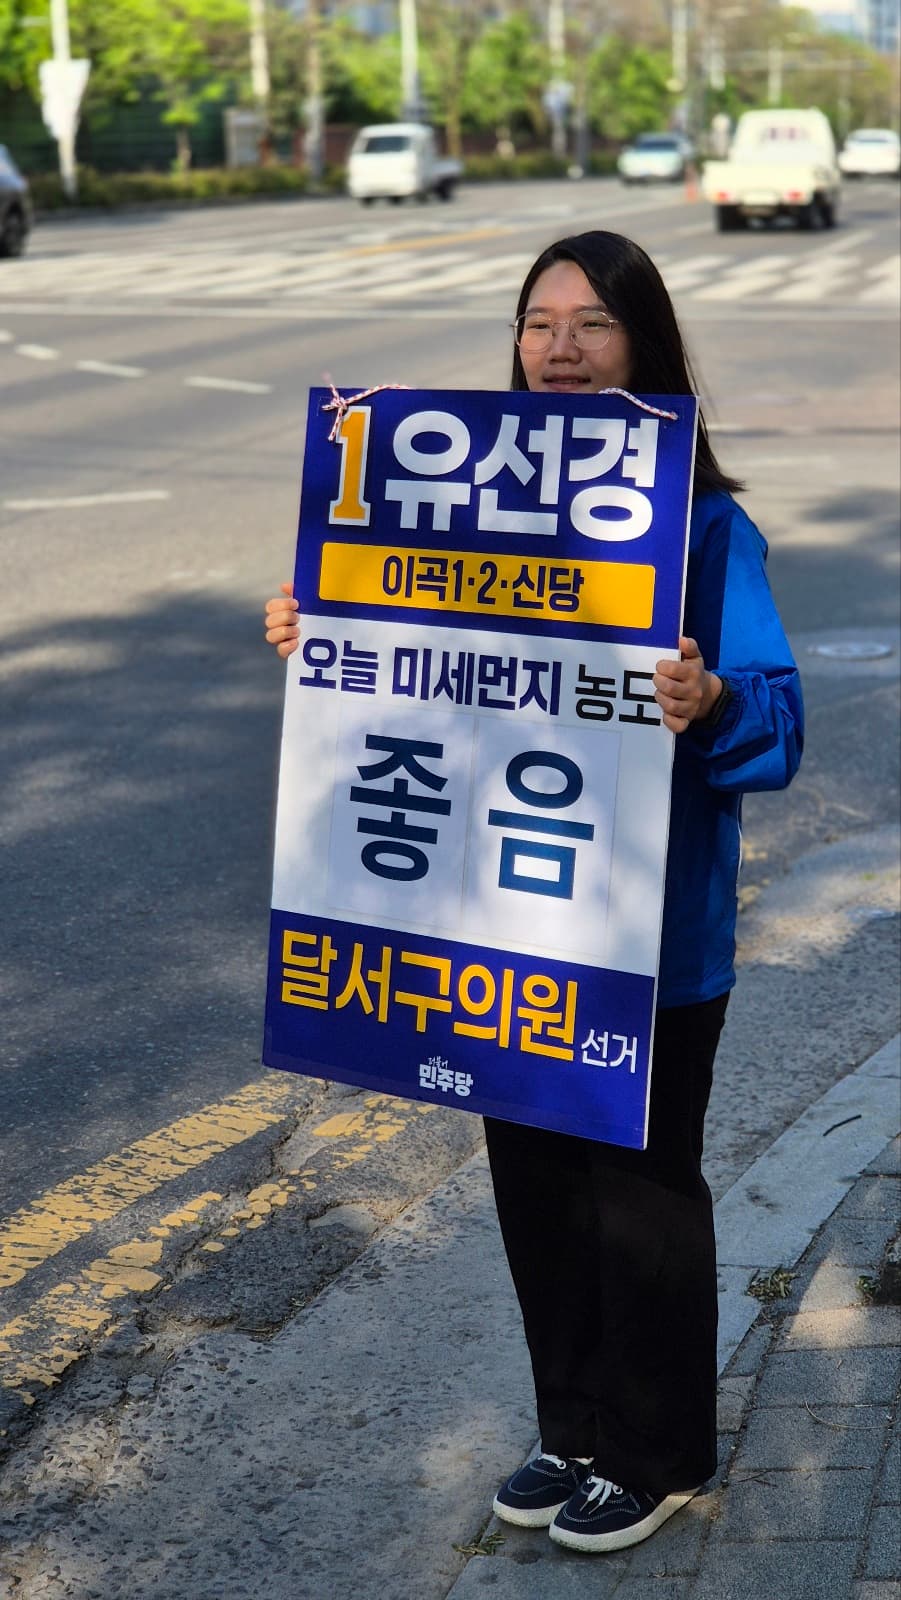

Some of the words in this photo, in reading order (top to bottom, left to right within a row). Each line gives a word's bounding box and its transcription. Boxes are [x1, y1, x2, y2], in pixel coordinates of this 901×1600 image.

[328, 405, 371, 526] 1
[385, 410, 660, 542] 유선경
[382, 555, 585, 613] 이곡1·2·신당
[299, 637, 379, 695] 오늘
[391, 647, 562, 716] 미세먼지
[575, 664, 661, 727] 농도
[349, 734, 595, 900] 좋음
[280, 929, 579, 1061] 달서구의원
[581, 1028, 638, 1074] 선거
[419, 1064, 474, 1097] 민주당
